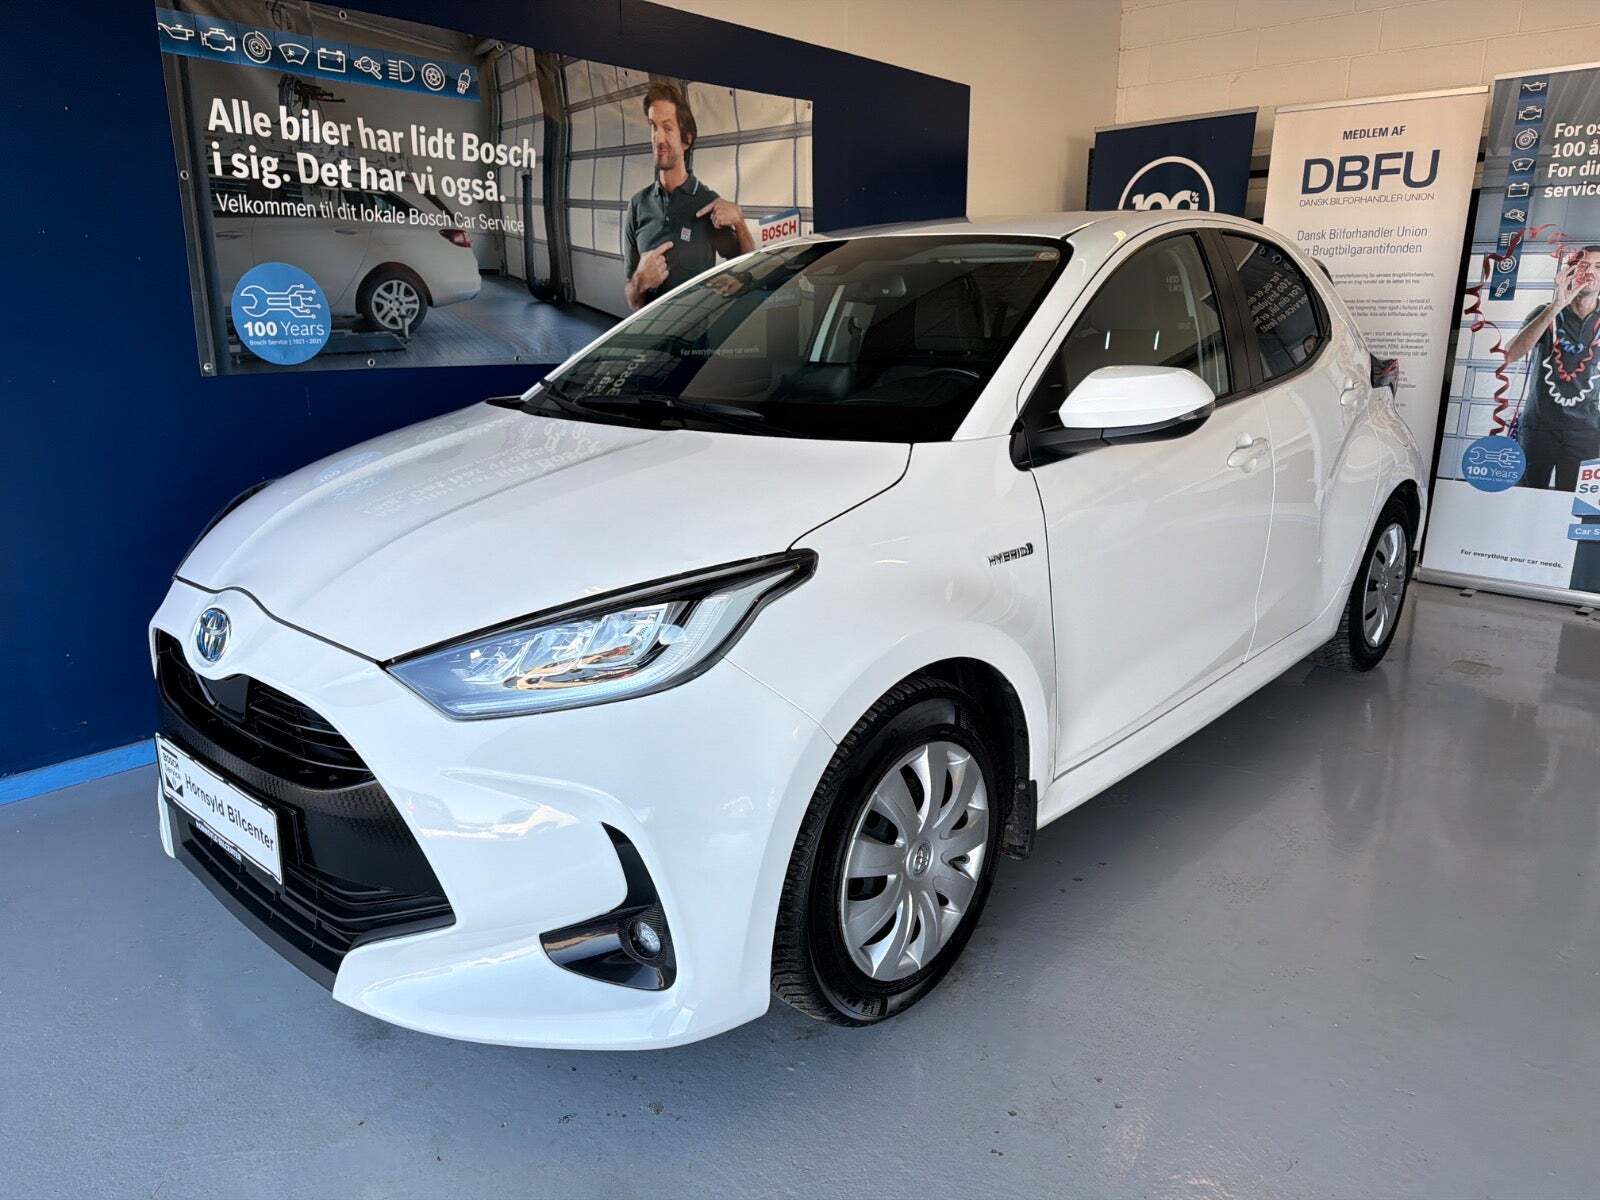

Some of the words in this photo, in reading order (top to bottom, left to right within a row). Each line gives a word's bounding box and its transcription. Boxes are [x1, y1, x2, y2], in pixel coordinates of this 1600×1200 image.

[208, 98, 272, 137] Alle
[280, 106, 351, 146] biler
[357, 117, 404, 153] har
[411, 124, 456, 160] lidt
[462, 132, 537, 169] Bosch
[1343, 128, 1389, 140] MEDLEM
[1391, 125, 1407, 136] AF
[1555, 123, 1583, 138] For
[1552, 141, 1586, 158] 100
[1589, 139, 1600, 156] å
[211, 141, 223, 177] i
[231, 145, 291, 189] sig.
[296, 152, 353, 189] Det
[360, 157, 406, 193] har
[412, 166, 436, 195] vi
[441, 171, 506, 206] også.
[1301, 149, 1440, 195] DBFU
[1548, 163, 1576, 178] For
[1299, 198, 1329, 207] DANSK
[1330, 194, 1403, 206] BILFORHANDLER
[1404, 193, 1435, 202] UNION
[215, 193, 317, 217] Velkommen
[319, 201, 334, 219] til
[337, 203, 357, 221] dit
[361, 203, 405, 225] lokale
[409, 208, 452, 228] Bosch
[454, 212, 476, 229] Car
[479, 214, 525, 232] Service
[762, 220, 797, 242] BOSCH
[1297, 229, 1326, 241] Dansk
[1329, 226, 1394, 240] Bilforhandler
[1397, 226, 1428, 238] Union
[1312, 243, 1422, 257] Brugtbilgarantifonden
[244, 321, 277, 337] 100
[281, 321, 325, 336] Years
[1467, 466, 1488, 476] 100
[1490, 468, 1519, 479] Years
[988, 546, 1028, 567] HYBRID
[1473, 551, 1509, 562] everything
[1540, 561, 1563, 569] needs.
[185, 774, 225, 816] Hornsyld
[227, 805, 274, 851] Bilcenter
